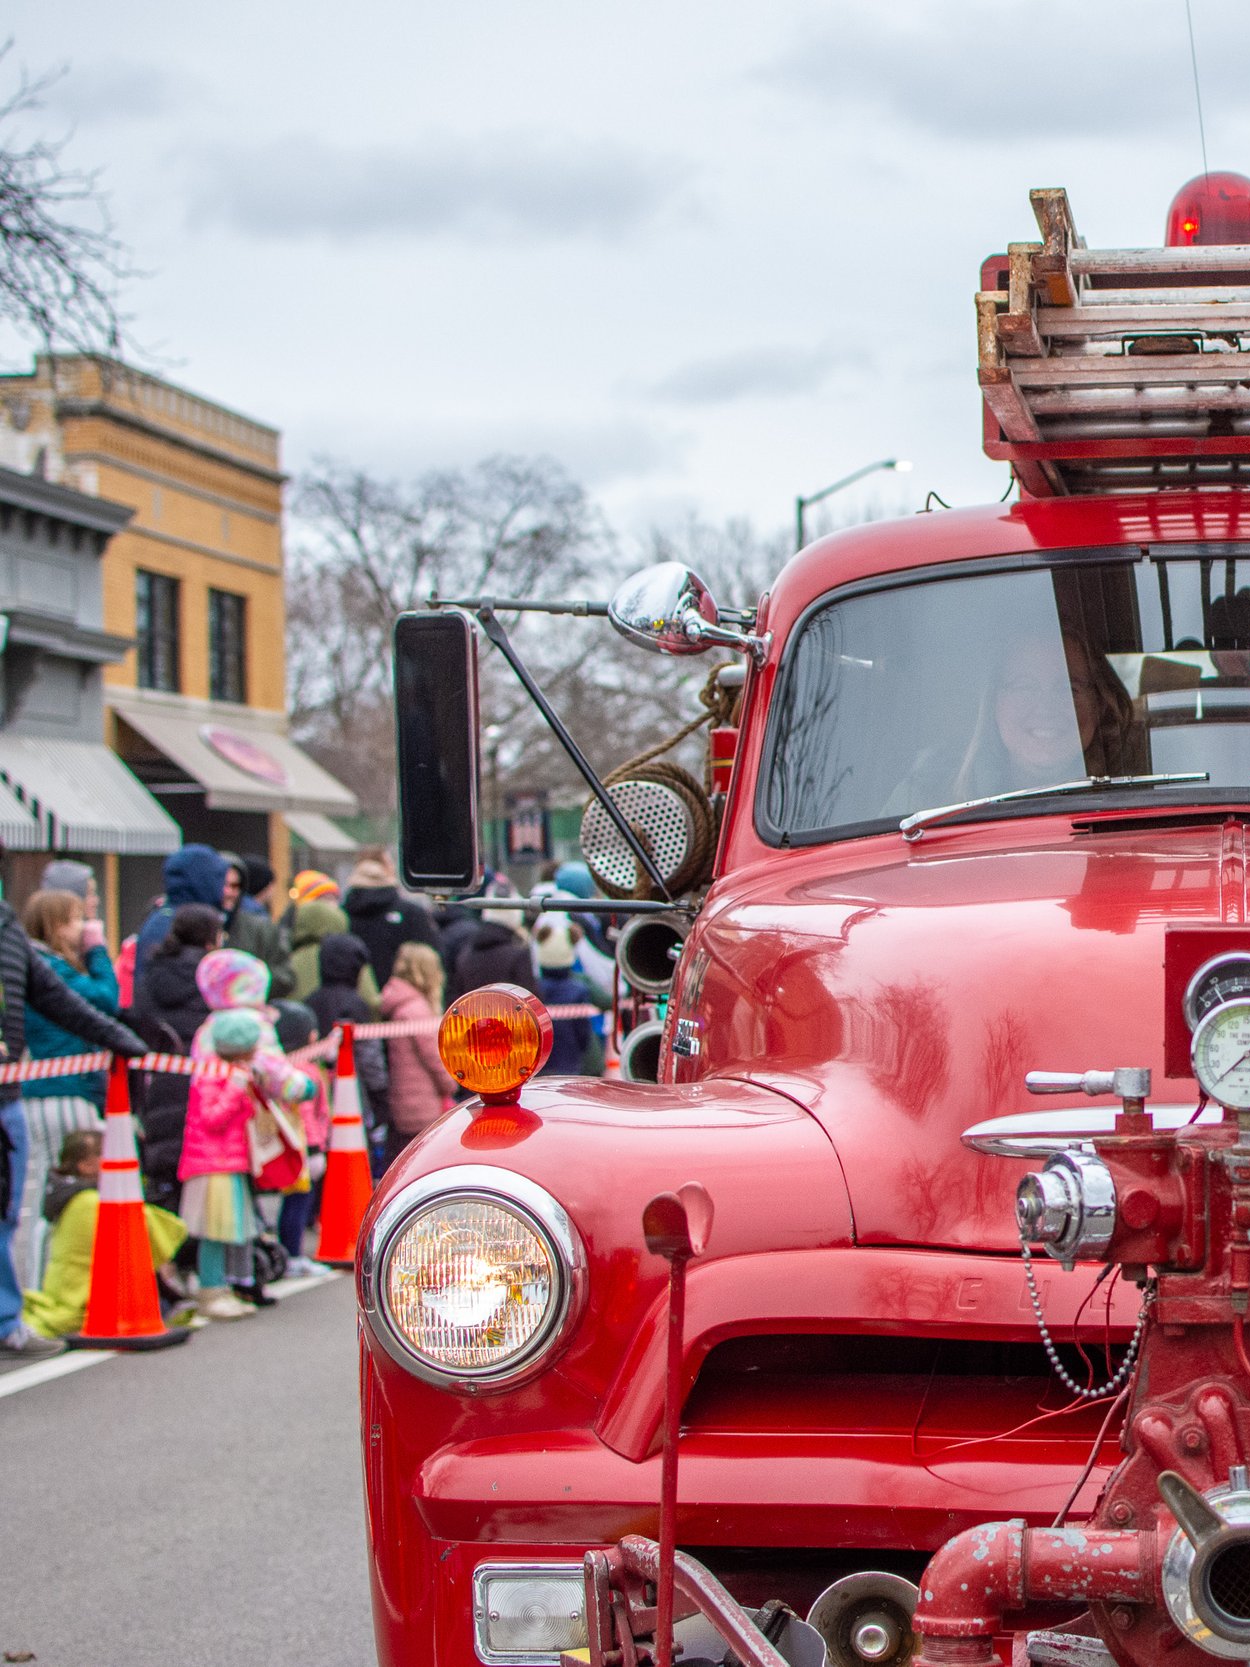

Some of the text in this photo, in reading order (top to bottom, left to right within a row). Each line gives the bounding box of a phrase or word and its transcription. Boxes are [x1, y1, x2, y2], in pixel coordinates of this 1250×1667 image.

[1209, 976, 1219, 985] 10
[1228, 1021, 1239, 1029] 120
[1217, 1030, 1226, 1038] 90
[1210, 1060, 1219, 1068] 30
